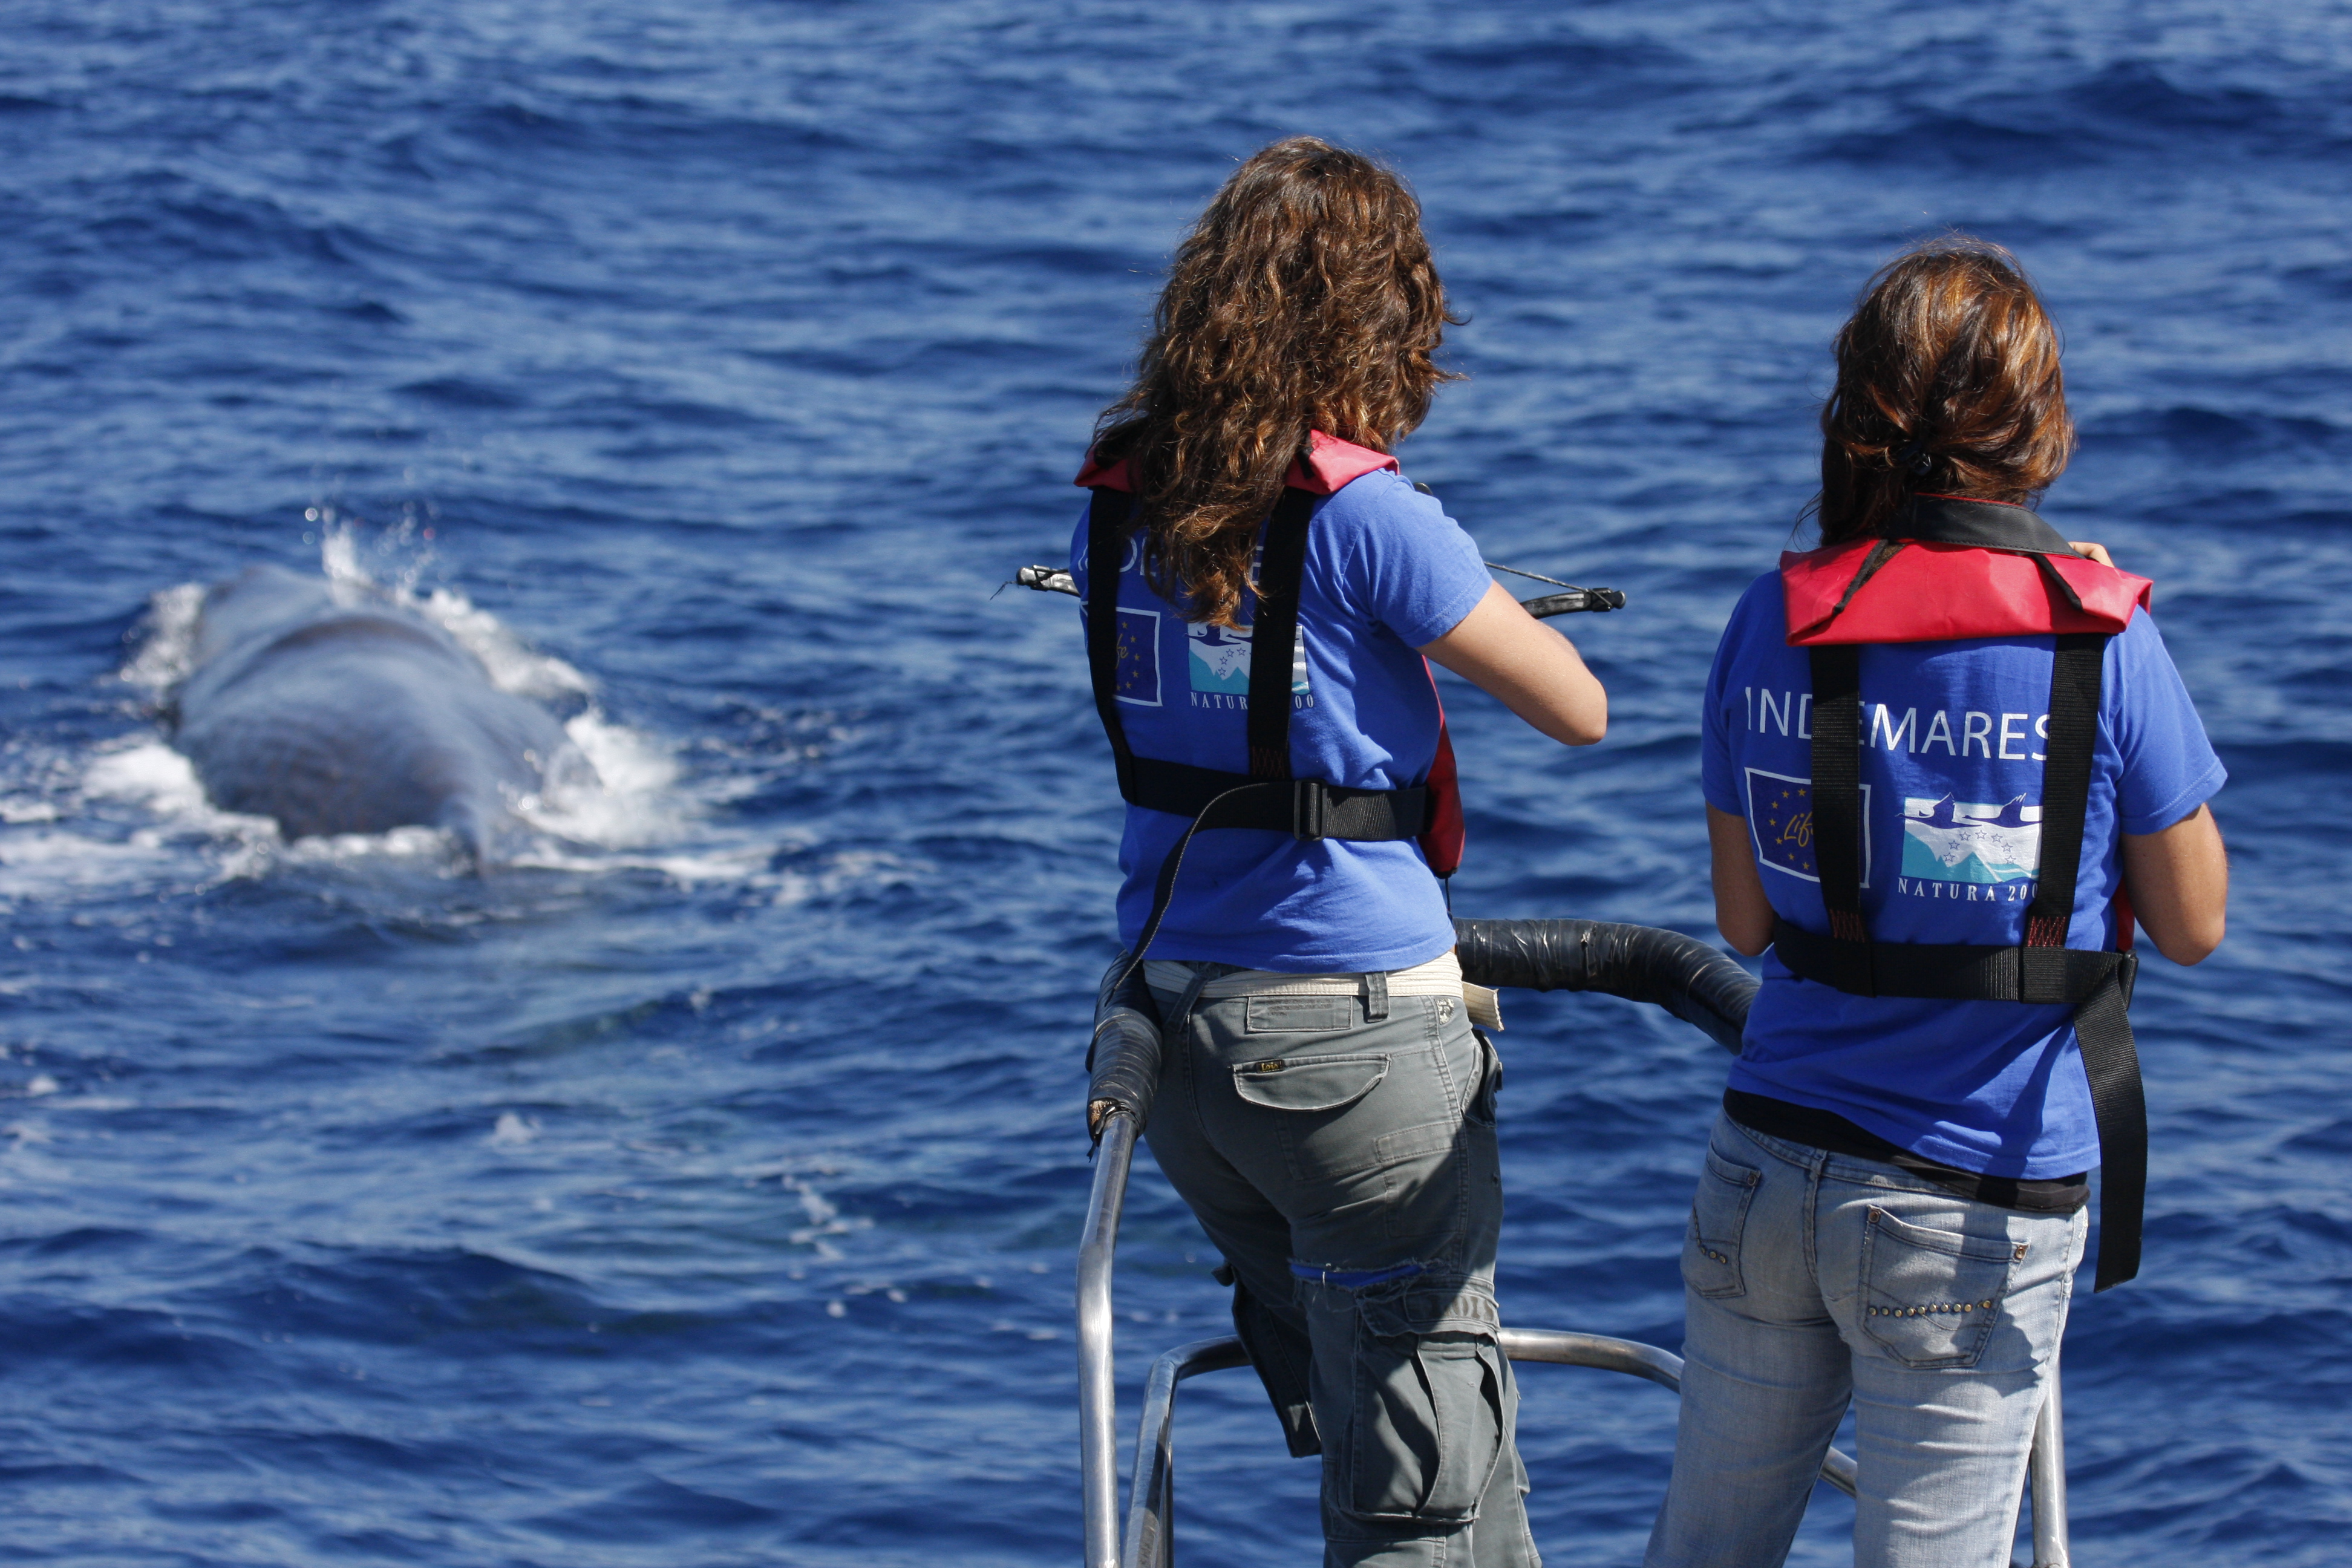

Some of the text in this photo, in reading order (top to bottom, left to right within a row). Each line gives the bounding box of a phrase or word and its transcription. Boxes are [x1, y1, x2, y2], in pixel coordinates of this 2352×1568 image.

[1190, 691, 1249, 710] NATUR
[1745, 687, 2050, 761] INMARES
[1783, 811, 1814, 847] Lif
[1898, 877, 2038, 902] NATURA 200
